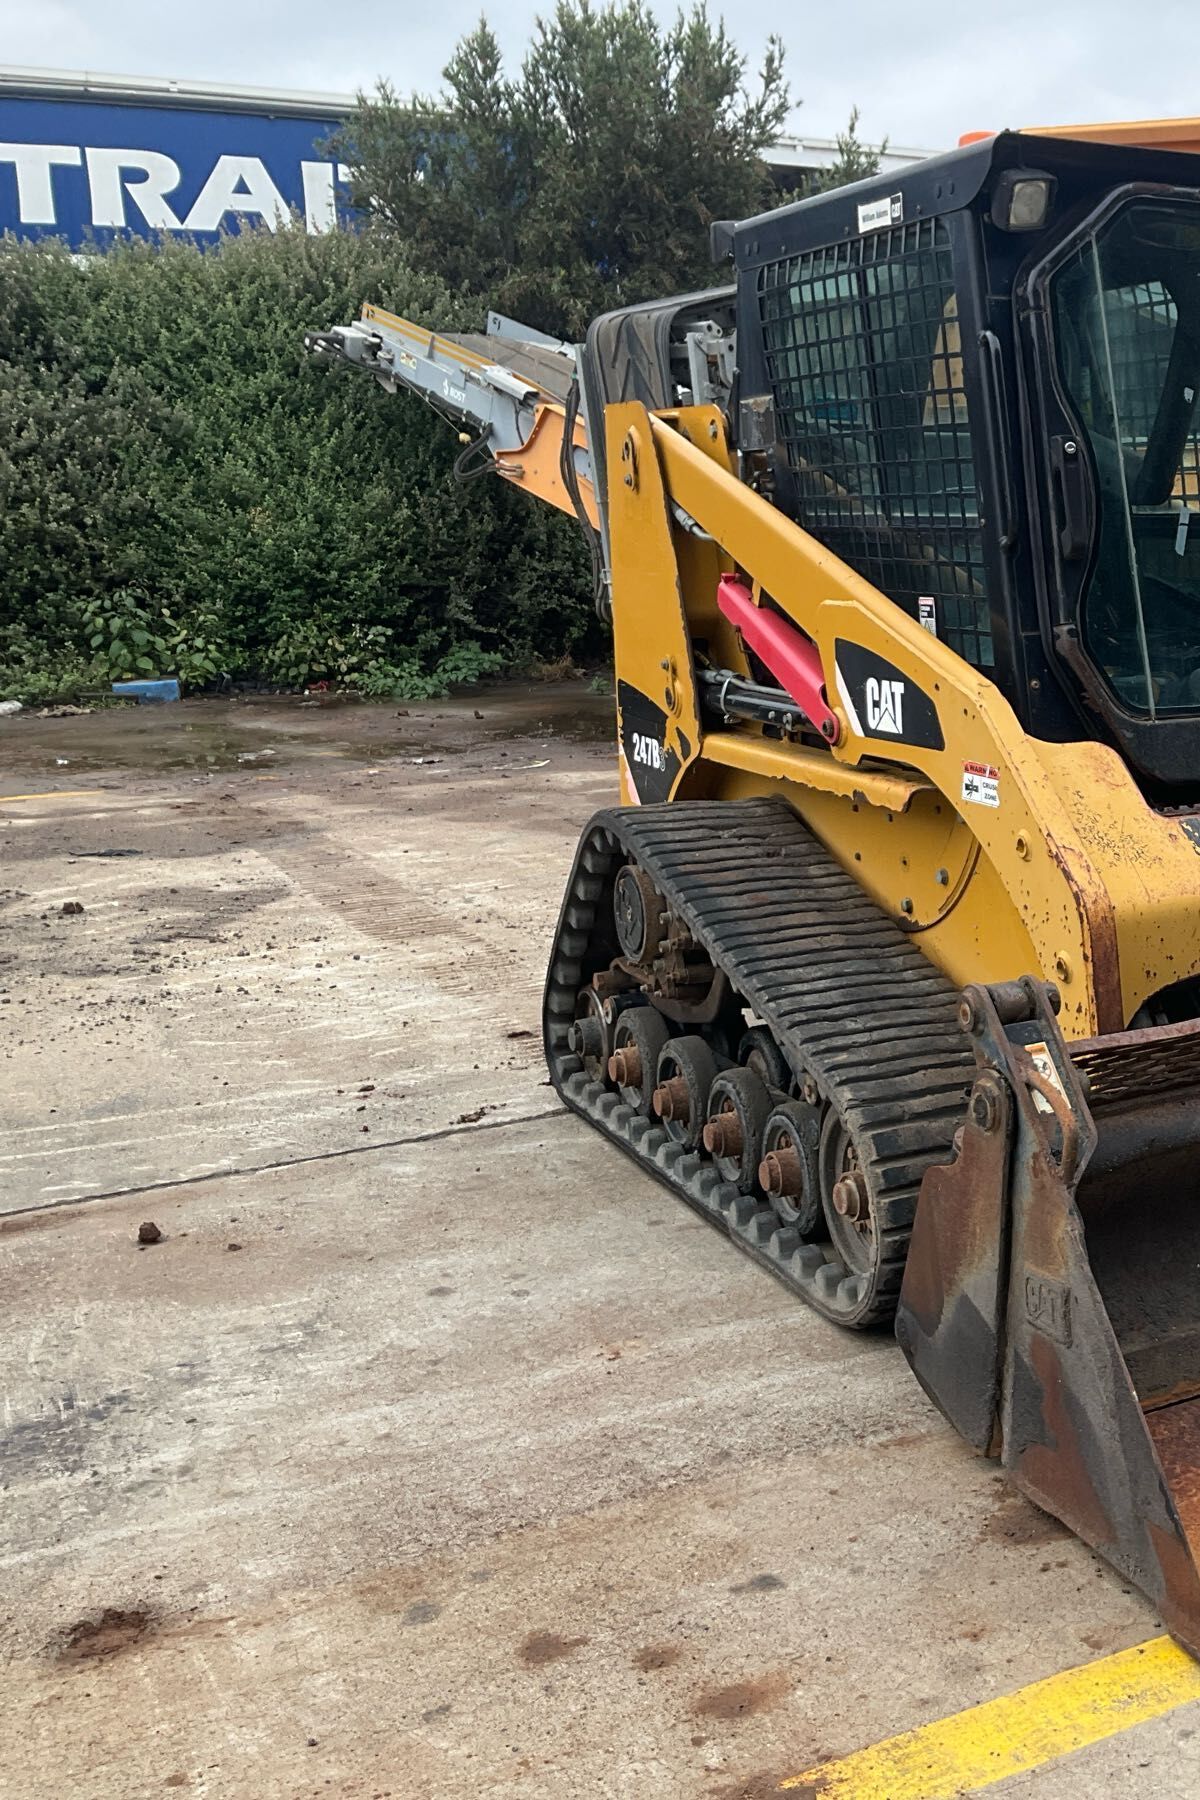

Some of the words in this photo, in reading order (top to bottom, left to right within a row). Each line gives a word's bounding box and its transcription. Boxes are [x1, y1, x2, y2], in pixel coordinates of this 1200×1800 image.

[0, 142, 358, 236] TRAI
[866, 677, 904, 734] CAT
[970, 764, 998, 777] WARNNG
